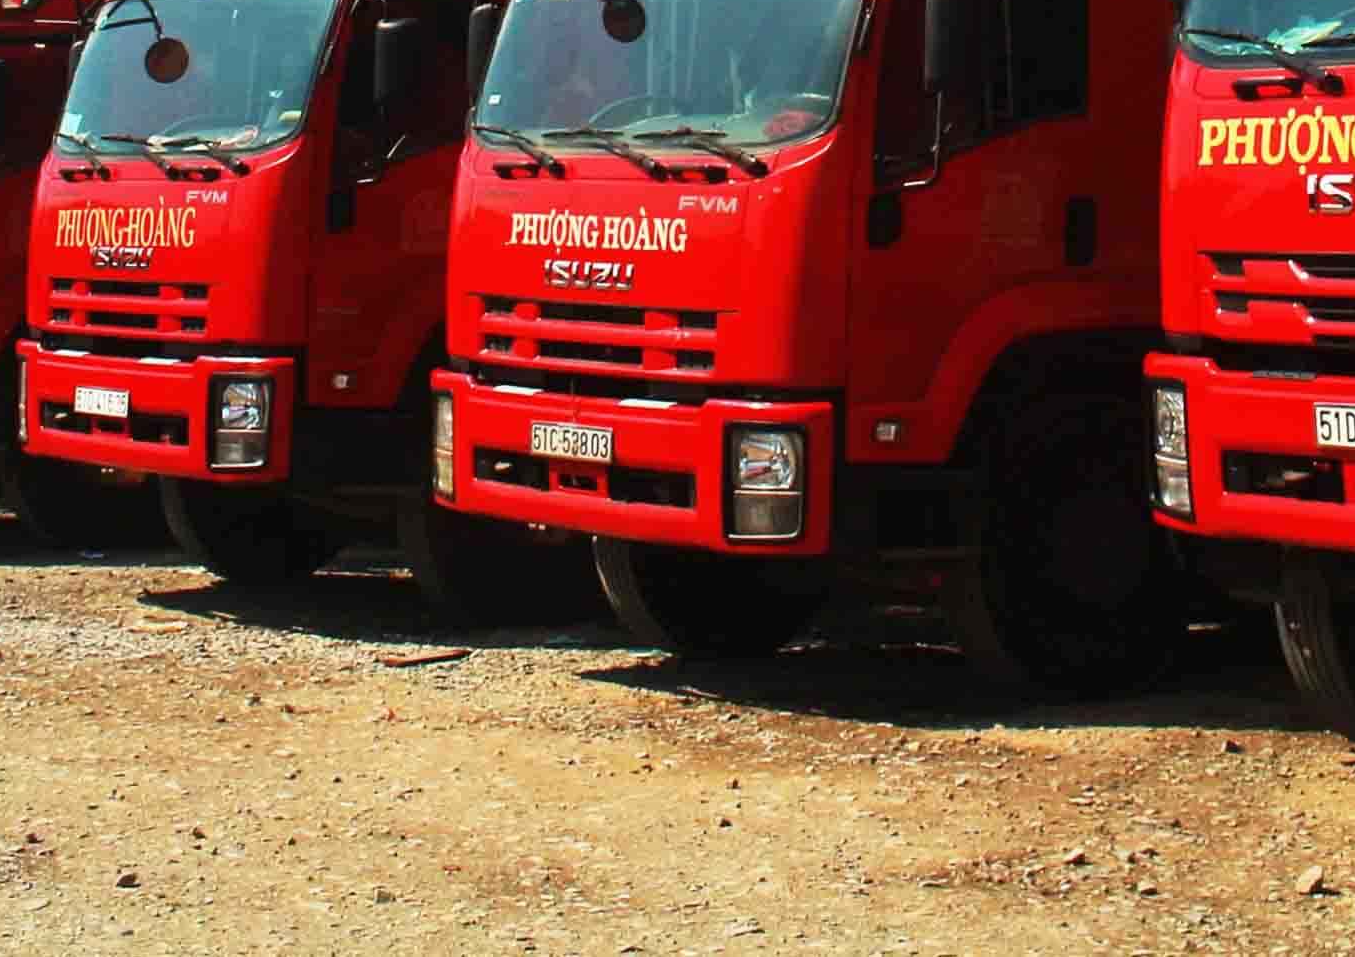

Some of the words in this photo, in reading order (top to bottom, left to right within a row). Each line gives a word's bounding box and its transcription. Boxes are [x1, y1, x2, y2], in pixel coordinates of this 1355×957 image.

[186, 191, 228, 203] FVM
[678, 195, 738, 213] FVM
[509, 208, 599, 253] PHƯỢNG
[601, 206, 688, 253] HOÀNG
[544, 258, 635, 291] ISUZU
